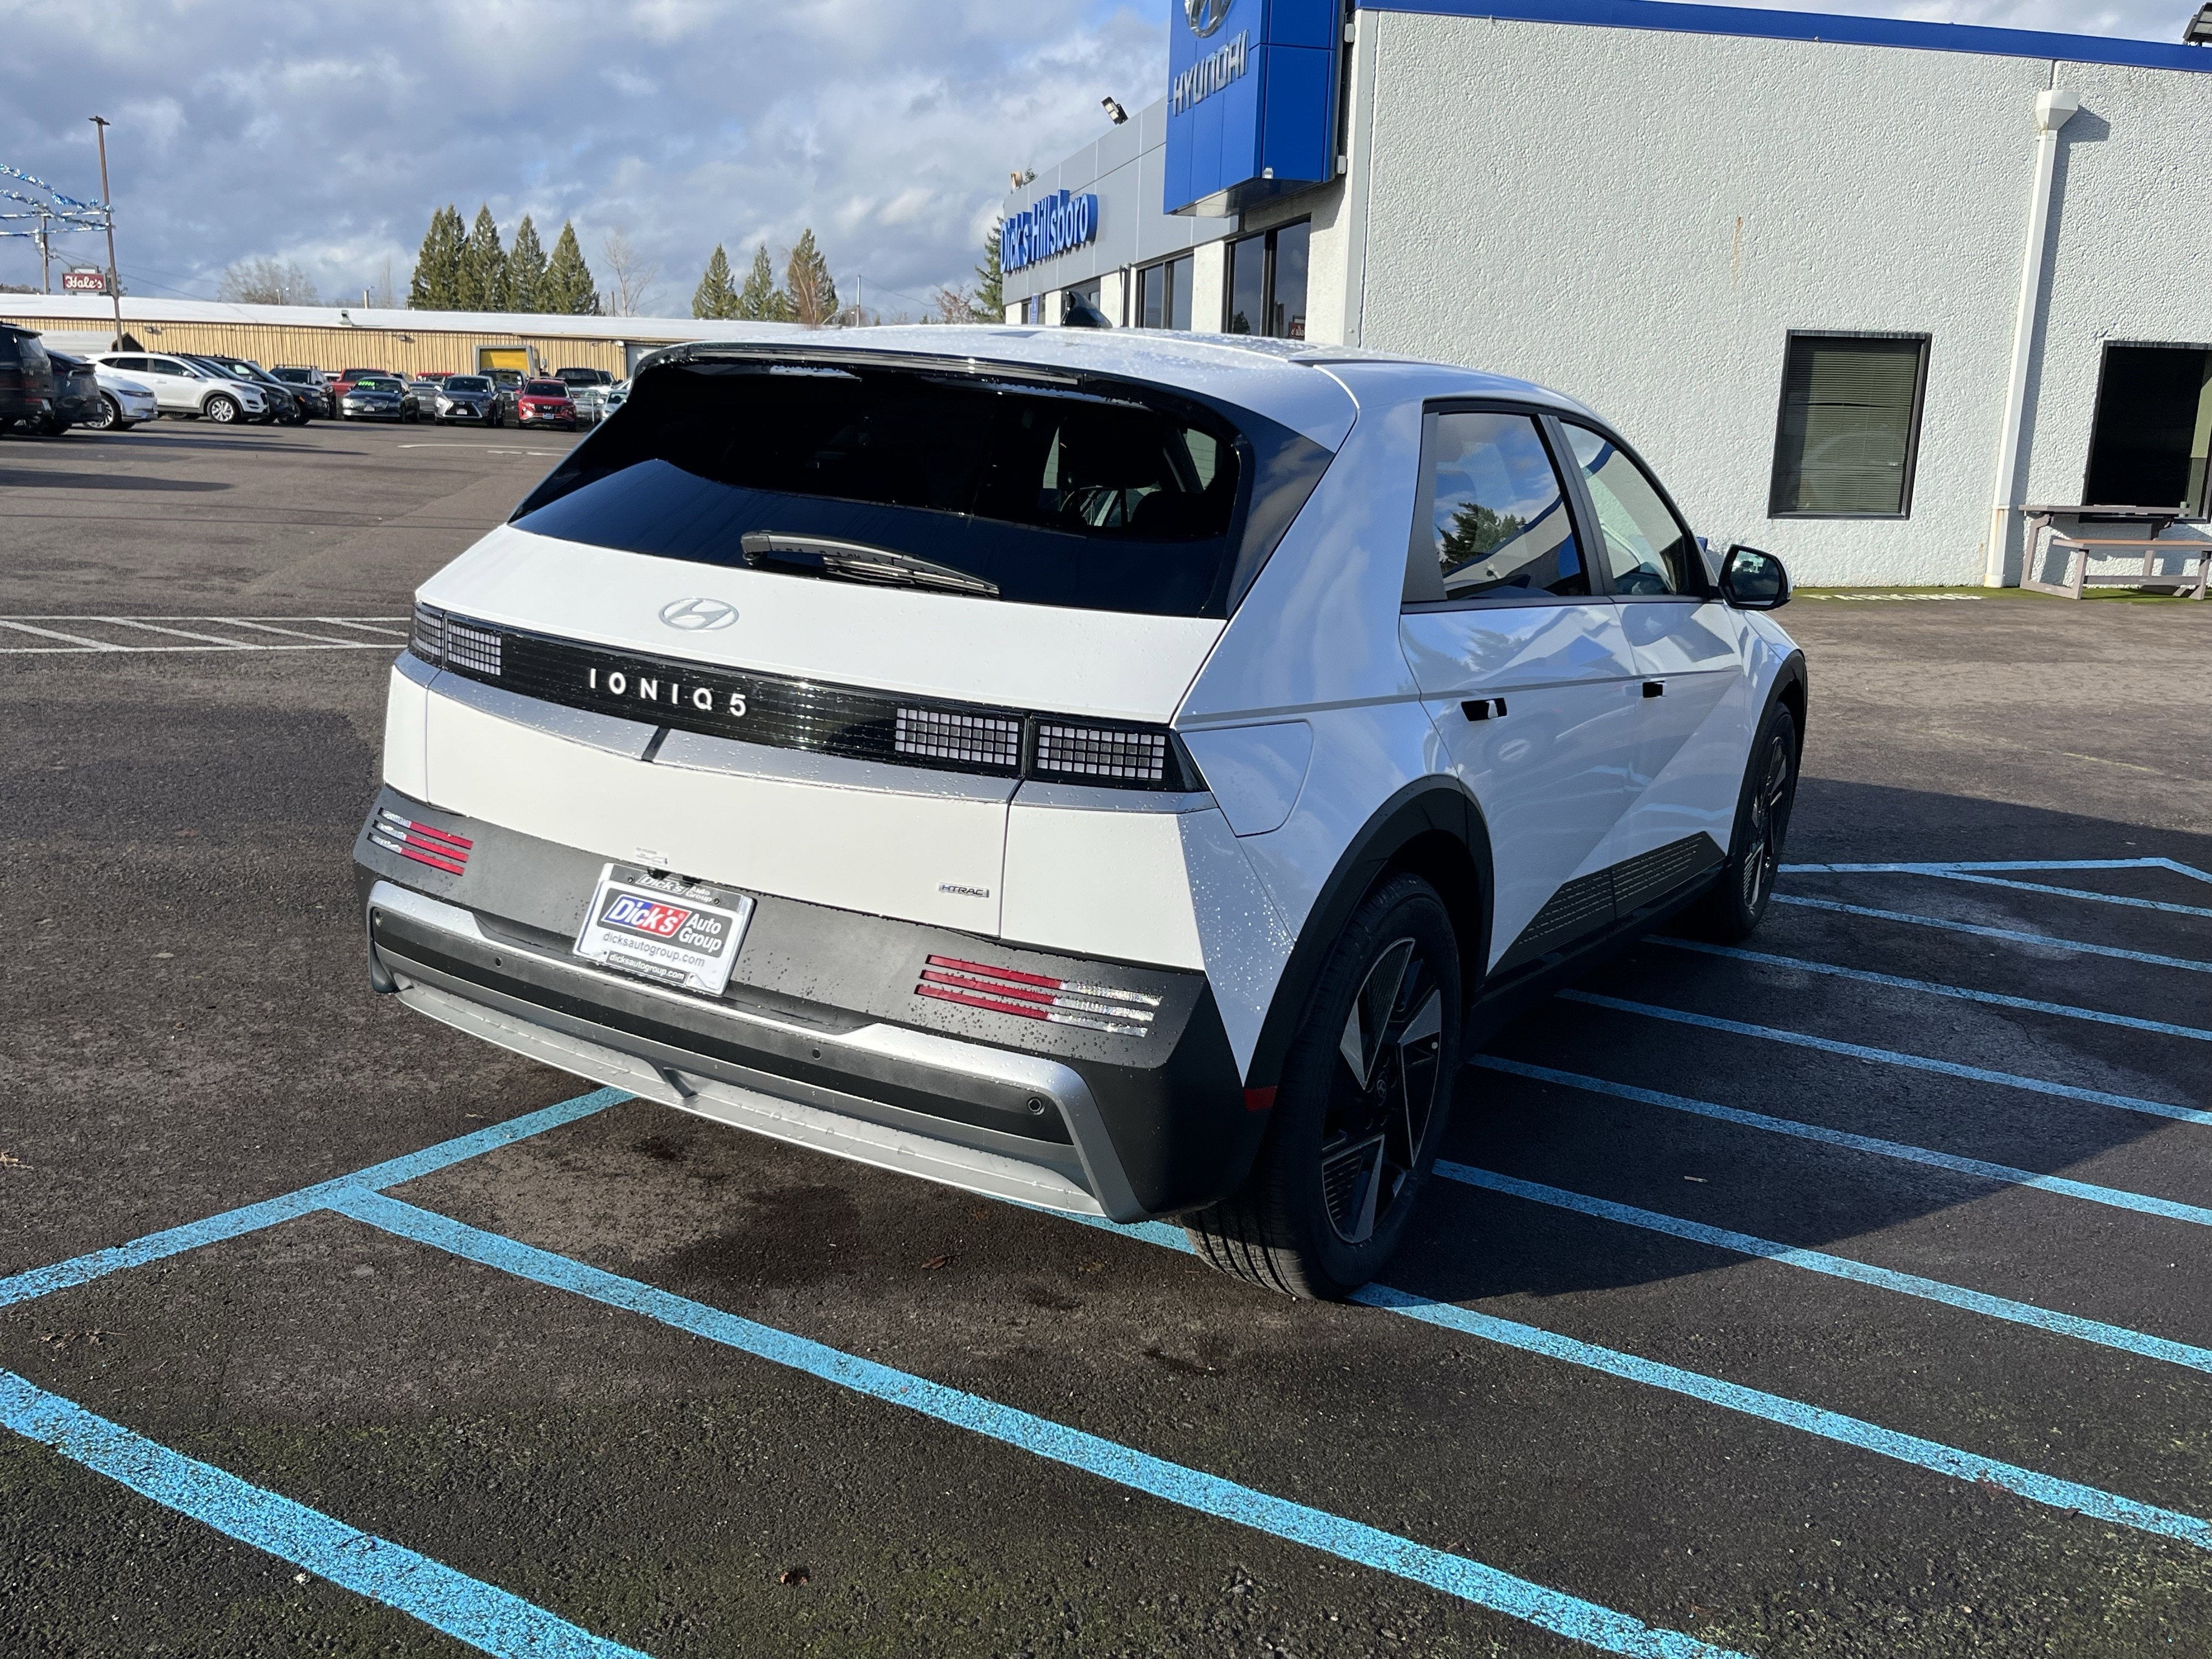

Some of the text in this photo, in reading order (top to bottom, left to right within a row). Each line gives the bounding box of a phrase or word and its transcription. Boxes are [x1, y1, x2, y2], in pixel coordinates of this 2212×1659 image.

[1173, 30, 1249, 117] HYUNDAI
[1001, 190, 1091, 273] Dick's Hillsboro
[65, 275, 103, 289] Hale's
[686, 891, 713, 902] Group
[691, 886, 710, 895] Auto
[941, 884, 984, 895] HTRAC
[685, 913, 722, 934] Auto
[603, 932, 705, 967] dicksautogroup.com
[678, 927, 723, 953] Group
[610, 953, 685, 980] dicksautogroup.com
